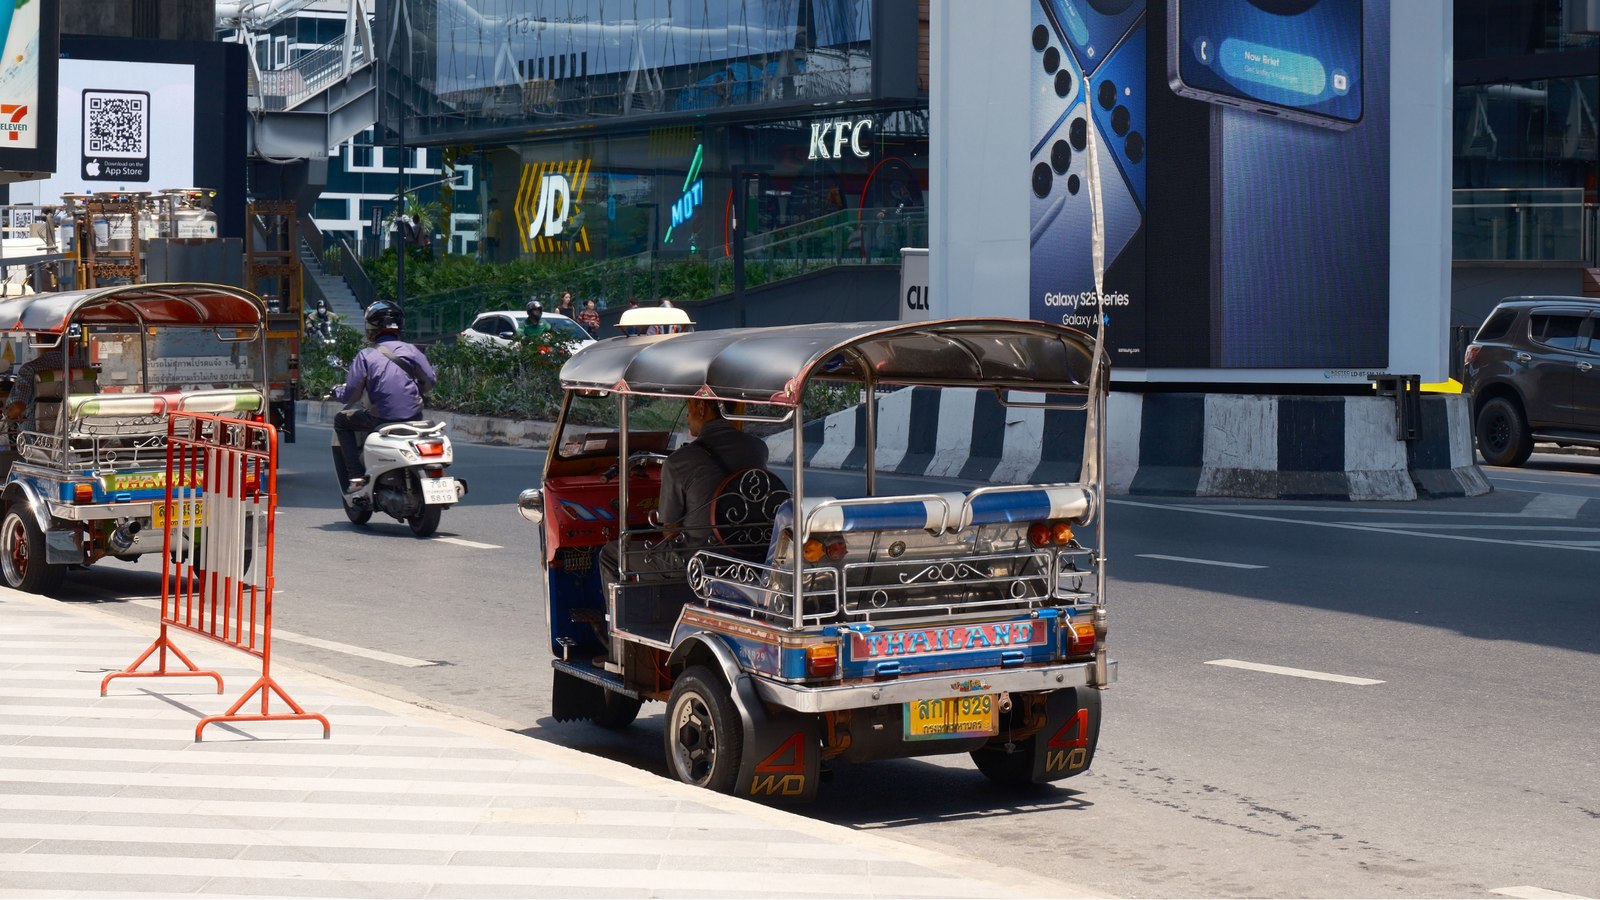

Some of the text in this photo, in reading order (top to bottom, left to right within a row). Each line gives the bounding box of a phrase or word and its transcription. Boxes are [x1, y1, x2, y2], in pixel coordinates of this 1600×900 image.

[808, 119, 872, 160] KFC
[105, 166, 143, 176] App Store
[529, 174, 571, 239] JD
[1044, 291, 1080, 310] Galaxy
[1080, 291, 1097, 306] S25
[1062, 313, 1092, 328] Galaxy
[430, 494, 452, 502] 5819
[866, 622, 1035, 657] THAILAND
[1047, 708, 1089, 748] 4
[755, 731, 805, 774] 4
[1045, 747, 1088, 773] WD
[750, 774, 806, 796] WD
